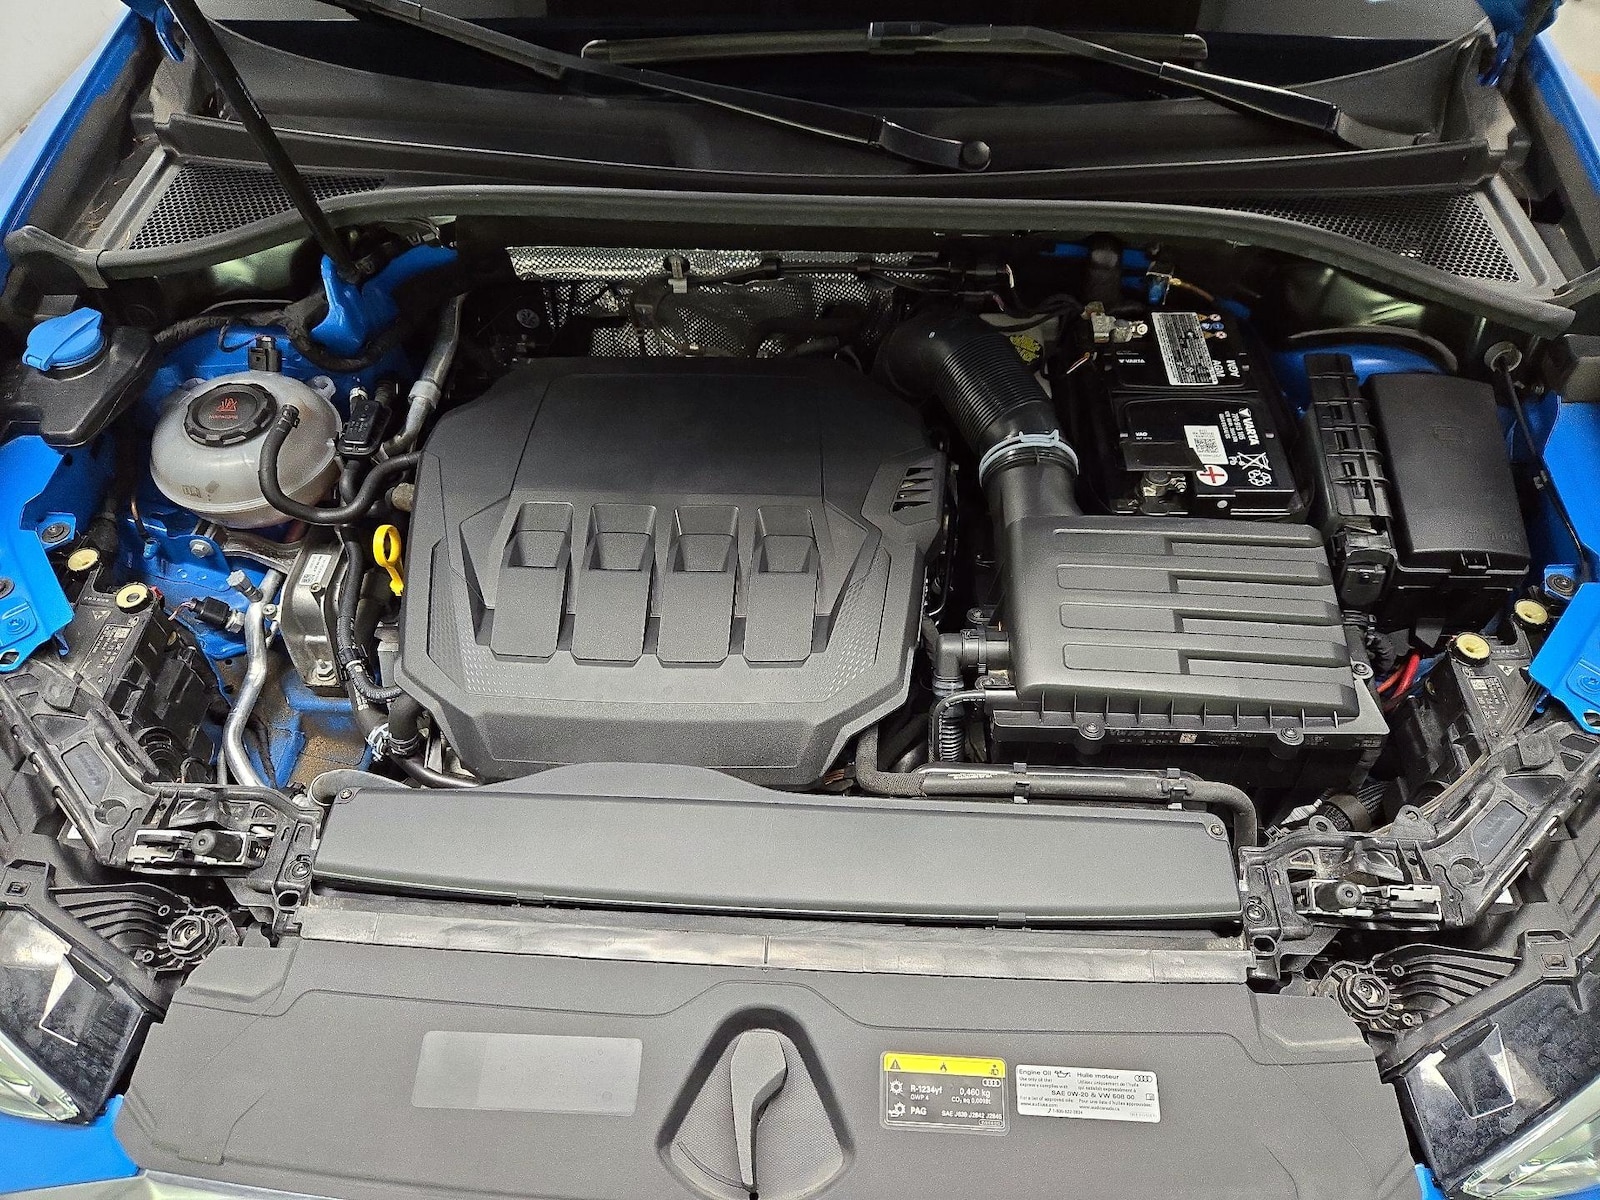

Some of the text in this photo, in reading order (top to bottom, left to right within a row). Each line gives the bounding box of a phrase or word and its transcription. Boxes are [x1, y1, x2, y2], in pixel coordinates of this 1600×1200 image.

[1212, 360, 1225, 378] AGM
[1243, 417, 1260, 446] VARTA
[1019, 1068, 1041, 1076] Engine
[910, 1084, 943, 1095] R-1234yf
[981, 1089, 991, 1098] kg
[910, 1106, 927, 1116] PAG
